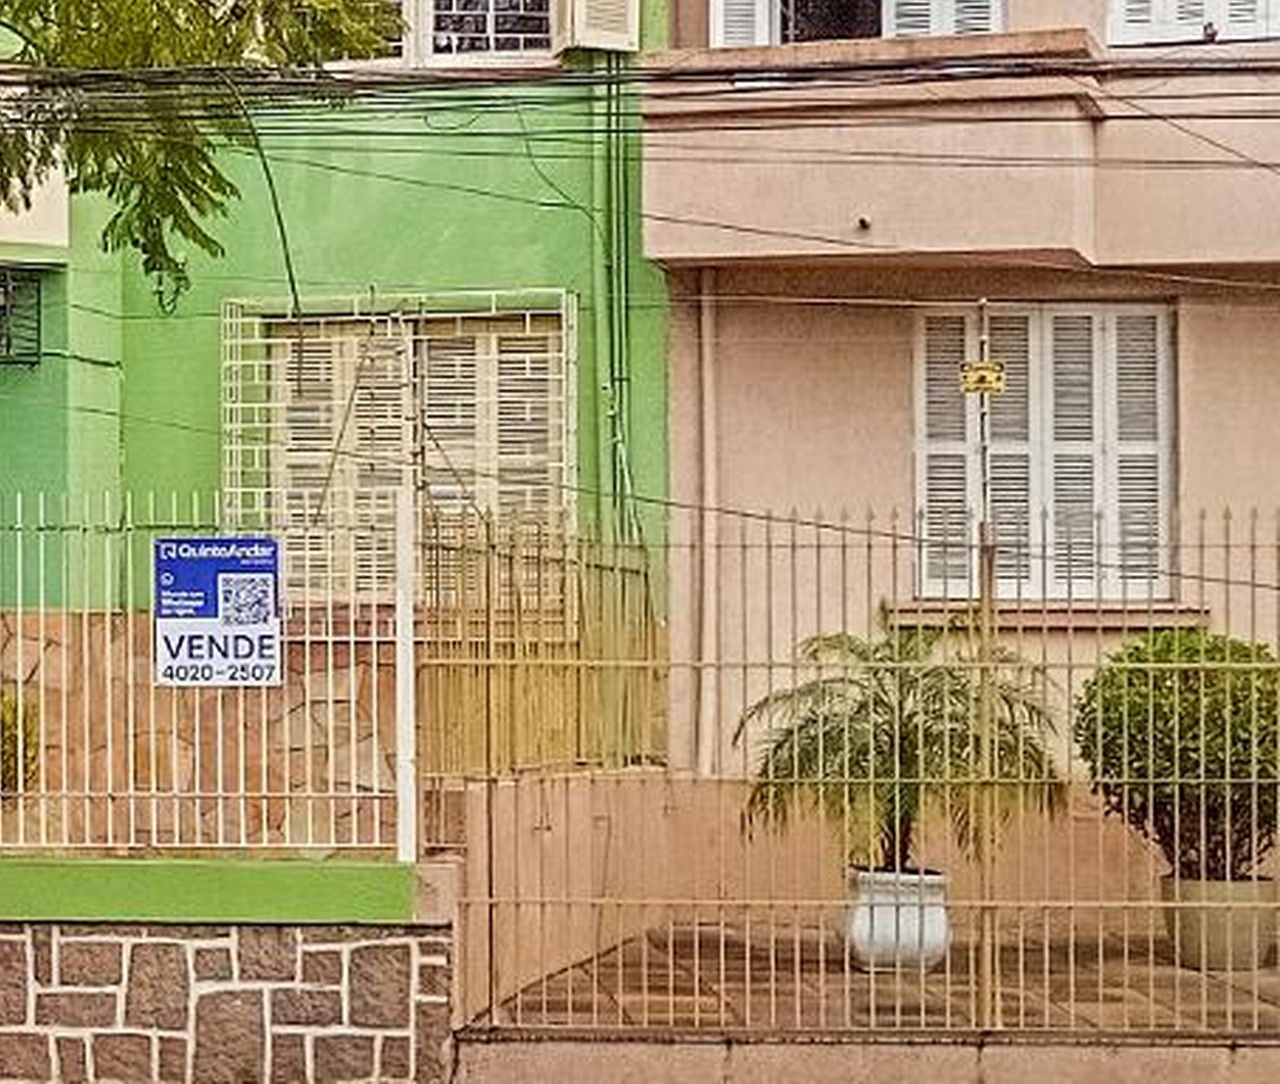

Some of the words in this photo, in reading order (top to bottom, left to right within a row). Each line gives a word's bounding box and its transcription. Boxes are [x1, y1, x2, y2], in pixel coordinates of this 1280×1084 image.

[178, 543, 275, 558] QuintoAndar
[163, 634, 275, 660] VENDE
[162, 664, 276, 682] 4020-2507
